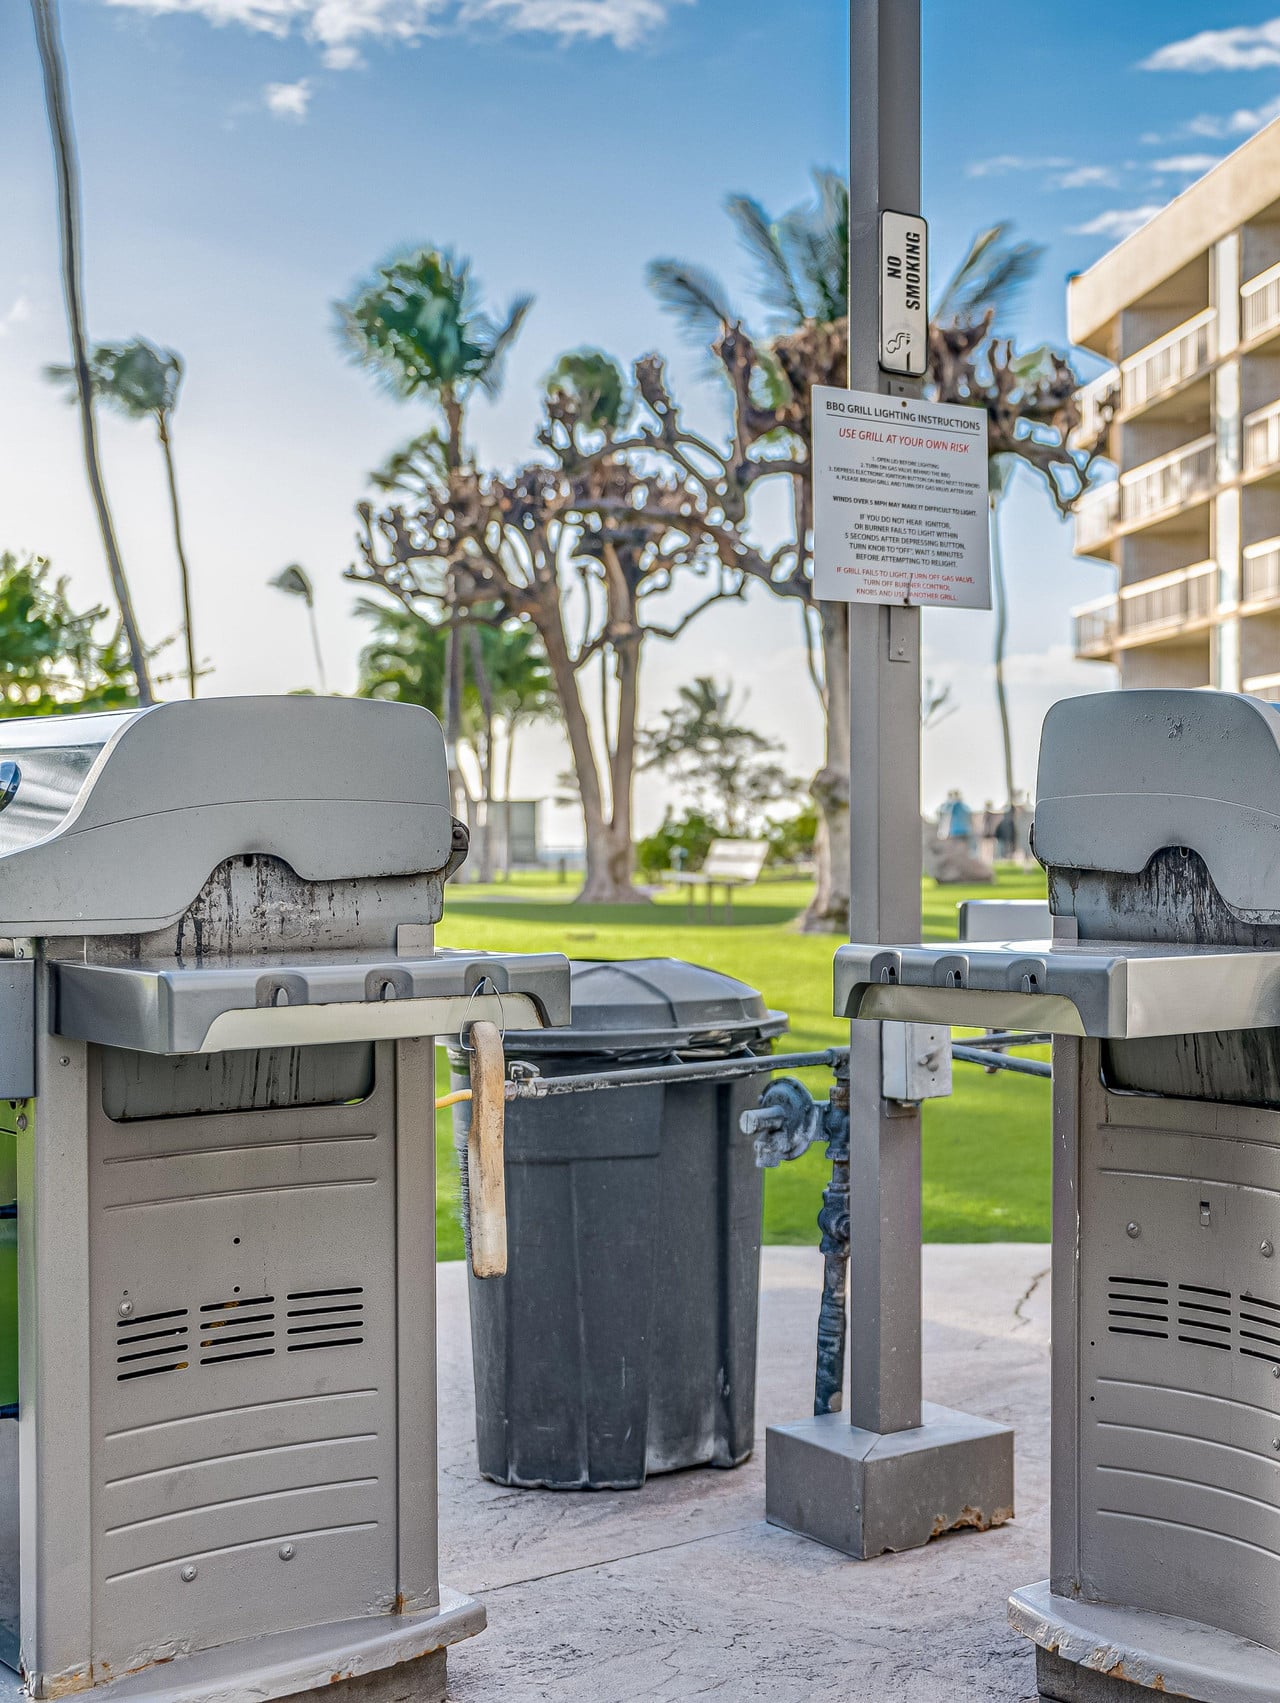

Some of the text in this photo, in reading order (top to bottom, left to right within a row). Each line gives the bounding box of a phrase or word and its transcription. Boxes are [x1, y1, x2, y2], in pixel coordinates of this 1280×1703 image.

[887, 255, 902, 279] NO
[906, 232, 920, 310] SMOKING
[826, 401, 980, 430] BBQ GRILL LIGHTING INSTRUCTIONS
[839, 428, 970, 454] USE GRILL AT YOUR OWN RISK
[832, 495, 852, 503] WINDS
[853, 497, 869, 505] OVER
[924, 505, 952, 514] DIFFICULT
[867, 514, 880, 522] YOU
[864, 524, 890, 533] BURNER
[890, 527, 907, 535] FAILS
[917, 529, 936, 537] LIGHT
[936, 531, 959, 539] WITHIN
[850, 532, 879, 541] SECONDS
[880, 535, 900, 543] AFTER
[901, 537, 939, 547] DEPRESSING
[849, 542, 867, 550] TURN
[867, 544, 886, 552] KNOB
[936, 551, 964, 559] MINUTES
[855, 553, 880, 561] BEFORE
[881, 555, 920, 565] ATTEMPTING
[843, 567, 861, 575] GRILL
[862, 569, 880, 577] FAILS
[910, 572, 928, 580] TURN
[863, 578, 880, 586] TURN
[894, 581, 921, 589] BURNER
[856, 588, 878, 596] KNOBS
[910, 592, 939, 600] ANOTHER
